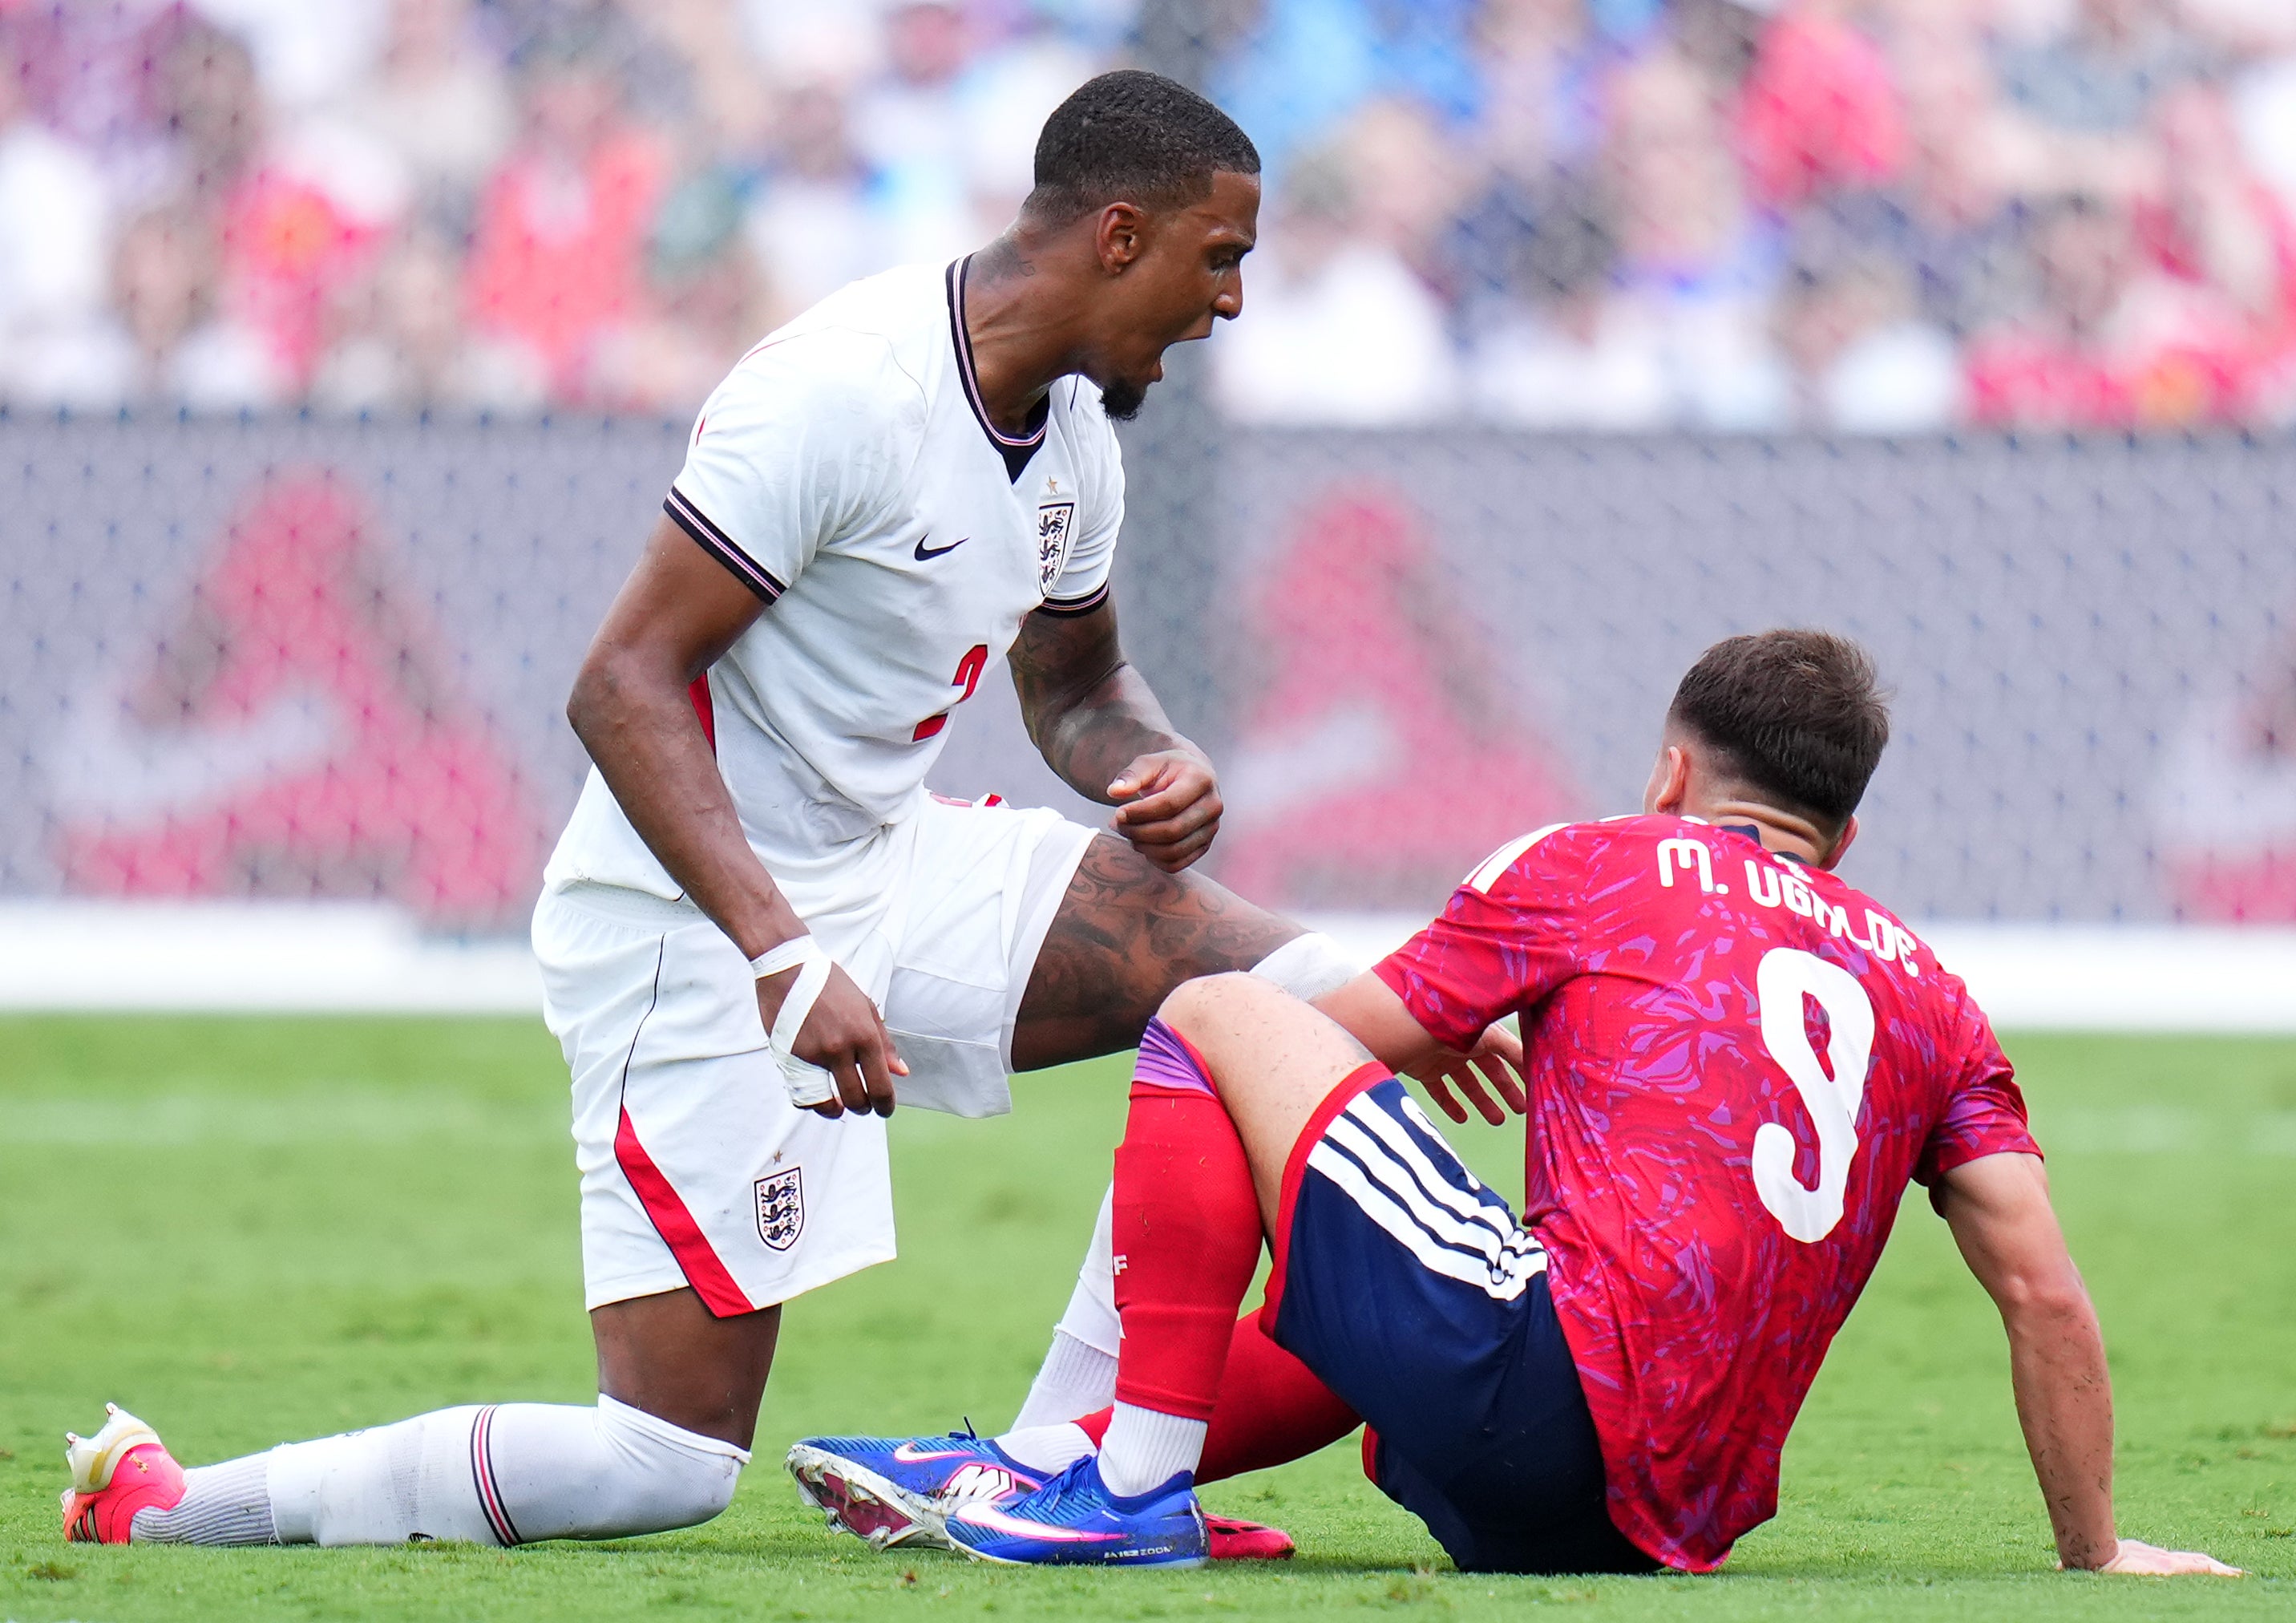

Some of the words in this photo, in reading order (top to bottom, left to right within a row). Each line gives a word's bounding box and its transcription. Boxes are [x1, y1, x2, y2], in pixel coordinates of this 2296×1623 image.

[912, 643, 988, 742] 2
[1656, 838, 1728, 895] M.
[1752, 947, 1875, 1244] 9
